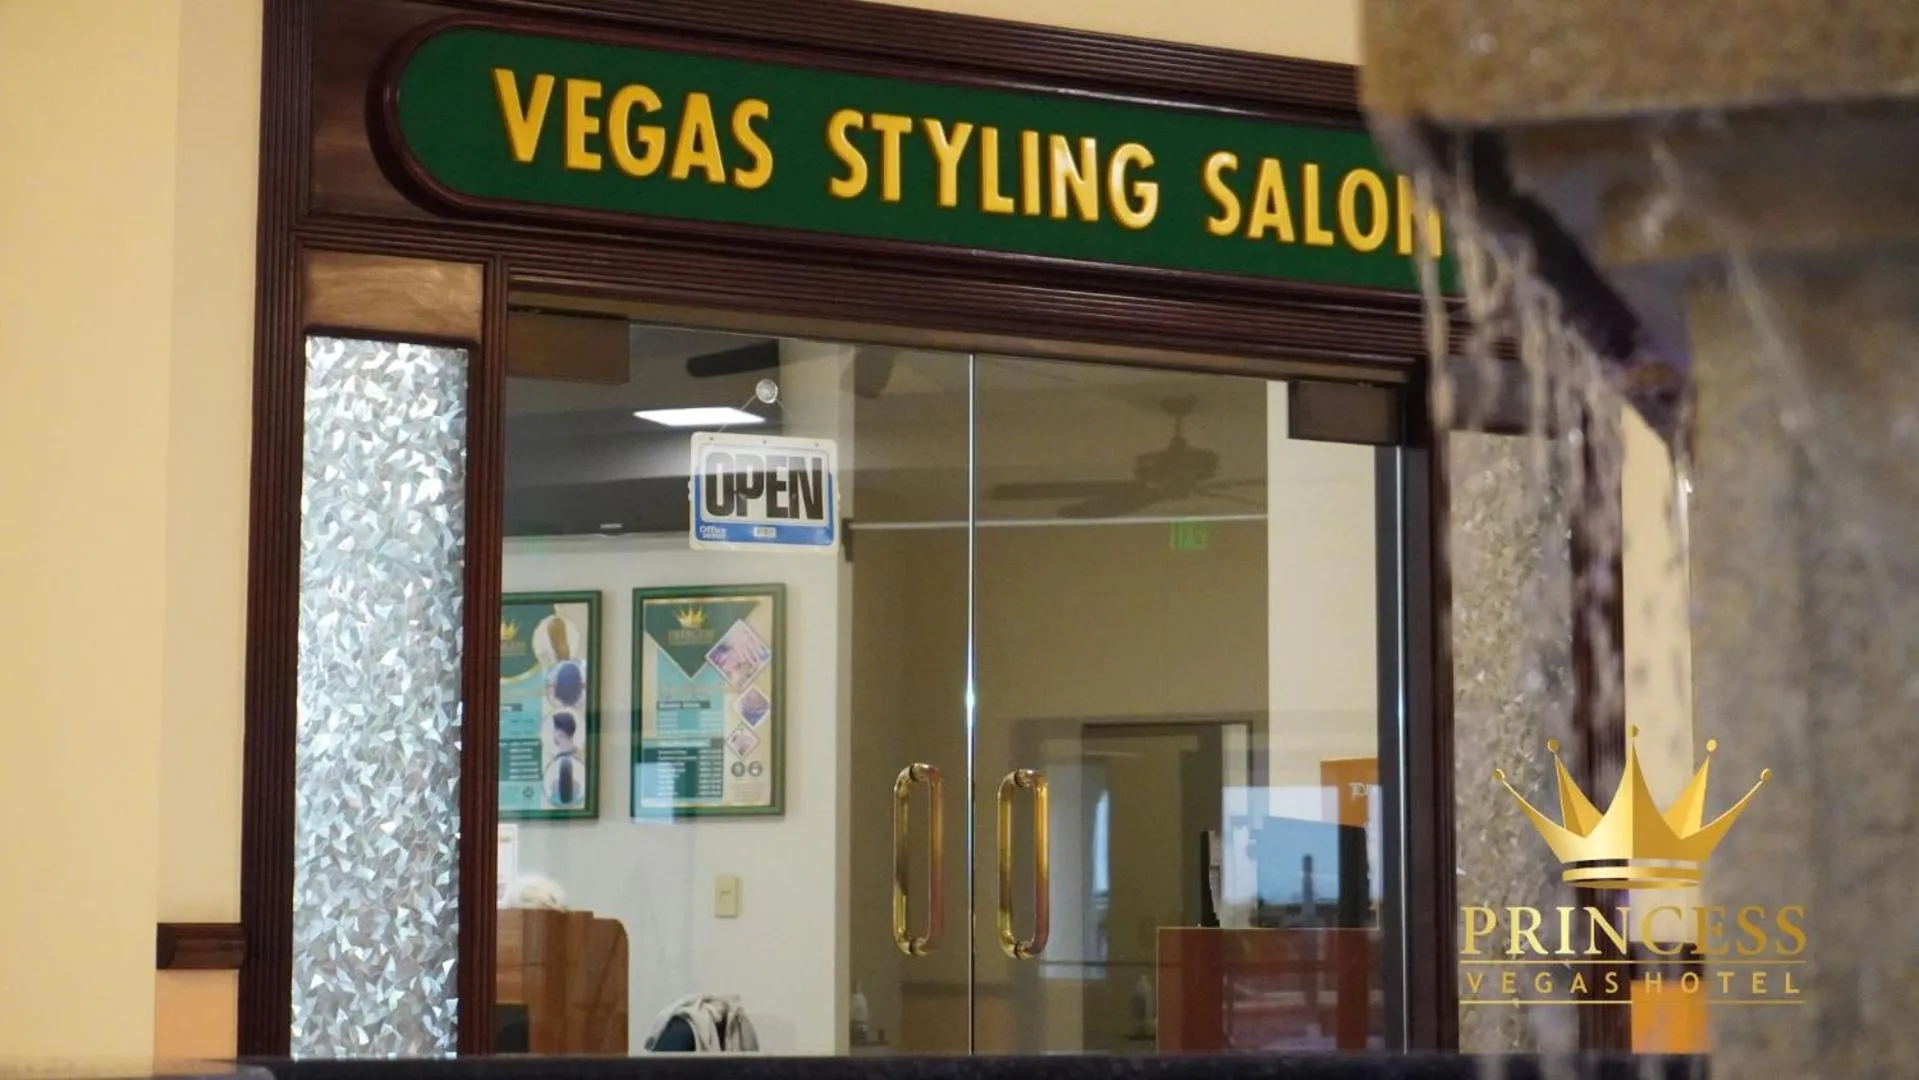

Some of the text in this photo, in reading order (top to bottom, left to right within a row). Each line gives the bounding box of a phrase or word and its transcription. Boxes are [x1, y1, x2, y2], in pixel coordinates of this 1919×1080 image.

[492, 67, 774, 190] VEGAS
[826, 108, 1159, 230] STYLING
[705, 452, 824, 520] OPEN
